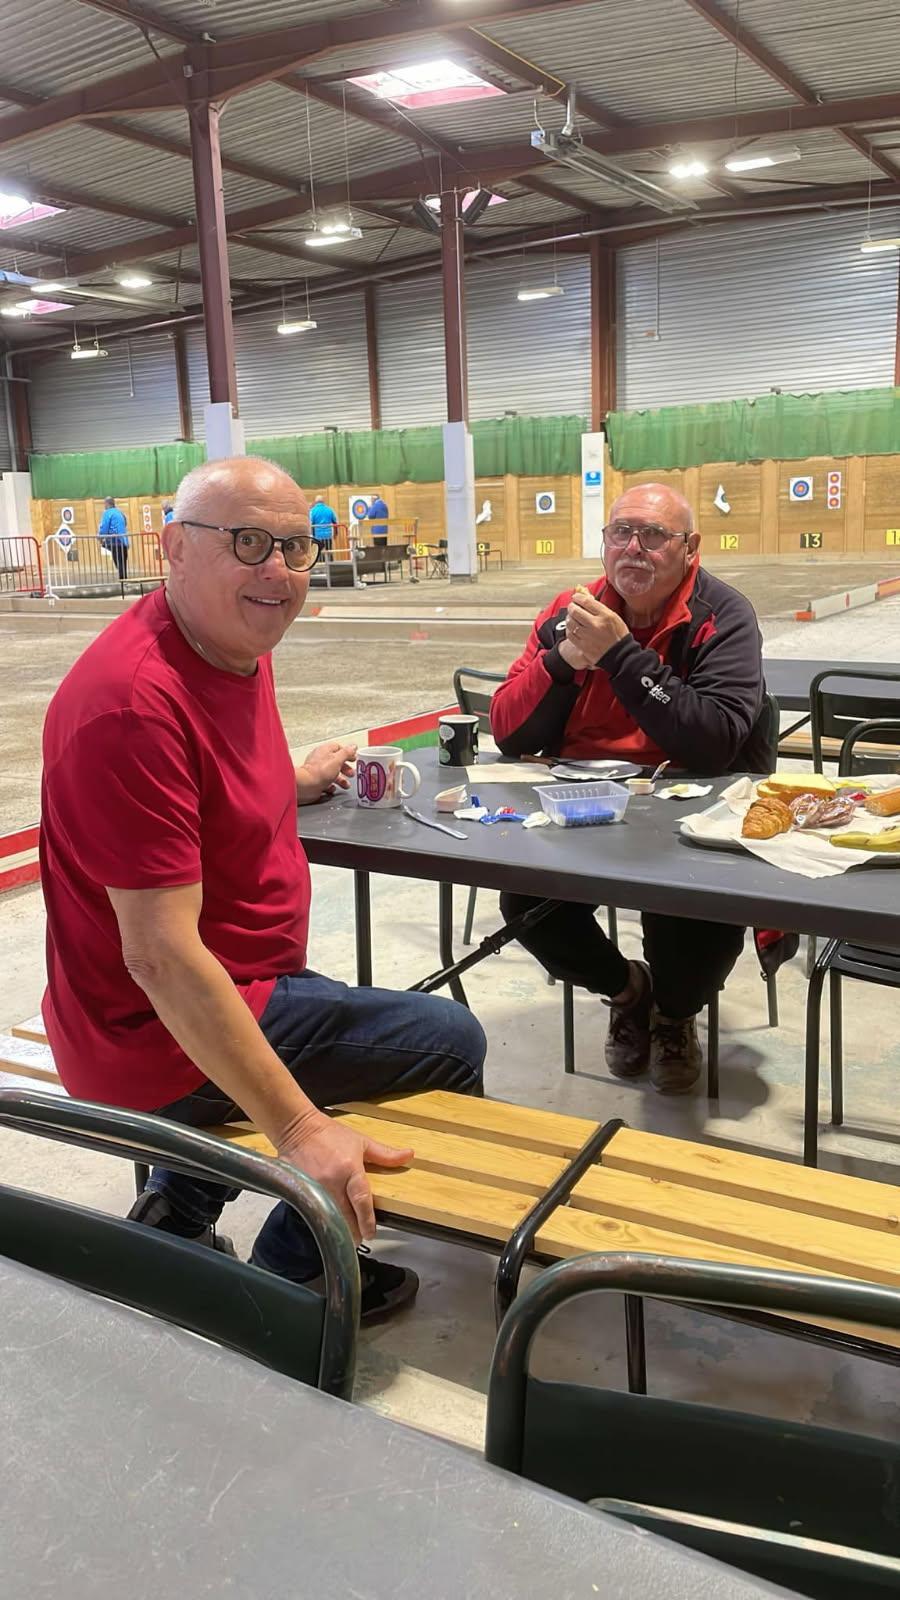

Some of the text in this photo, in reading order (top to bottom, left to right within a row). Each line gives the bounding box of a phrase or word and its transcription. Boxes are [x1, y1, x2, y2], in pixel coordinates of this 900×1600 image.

[541, 541, 553, 553] 10
[723, 535, 738, 549] 12
[804, 533, 821, 548] 13
